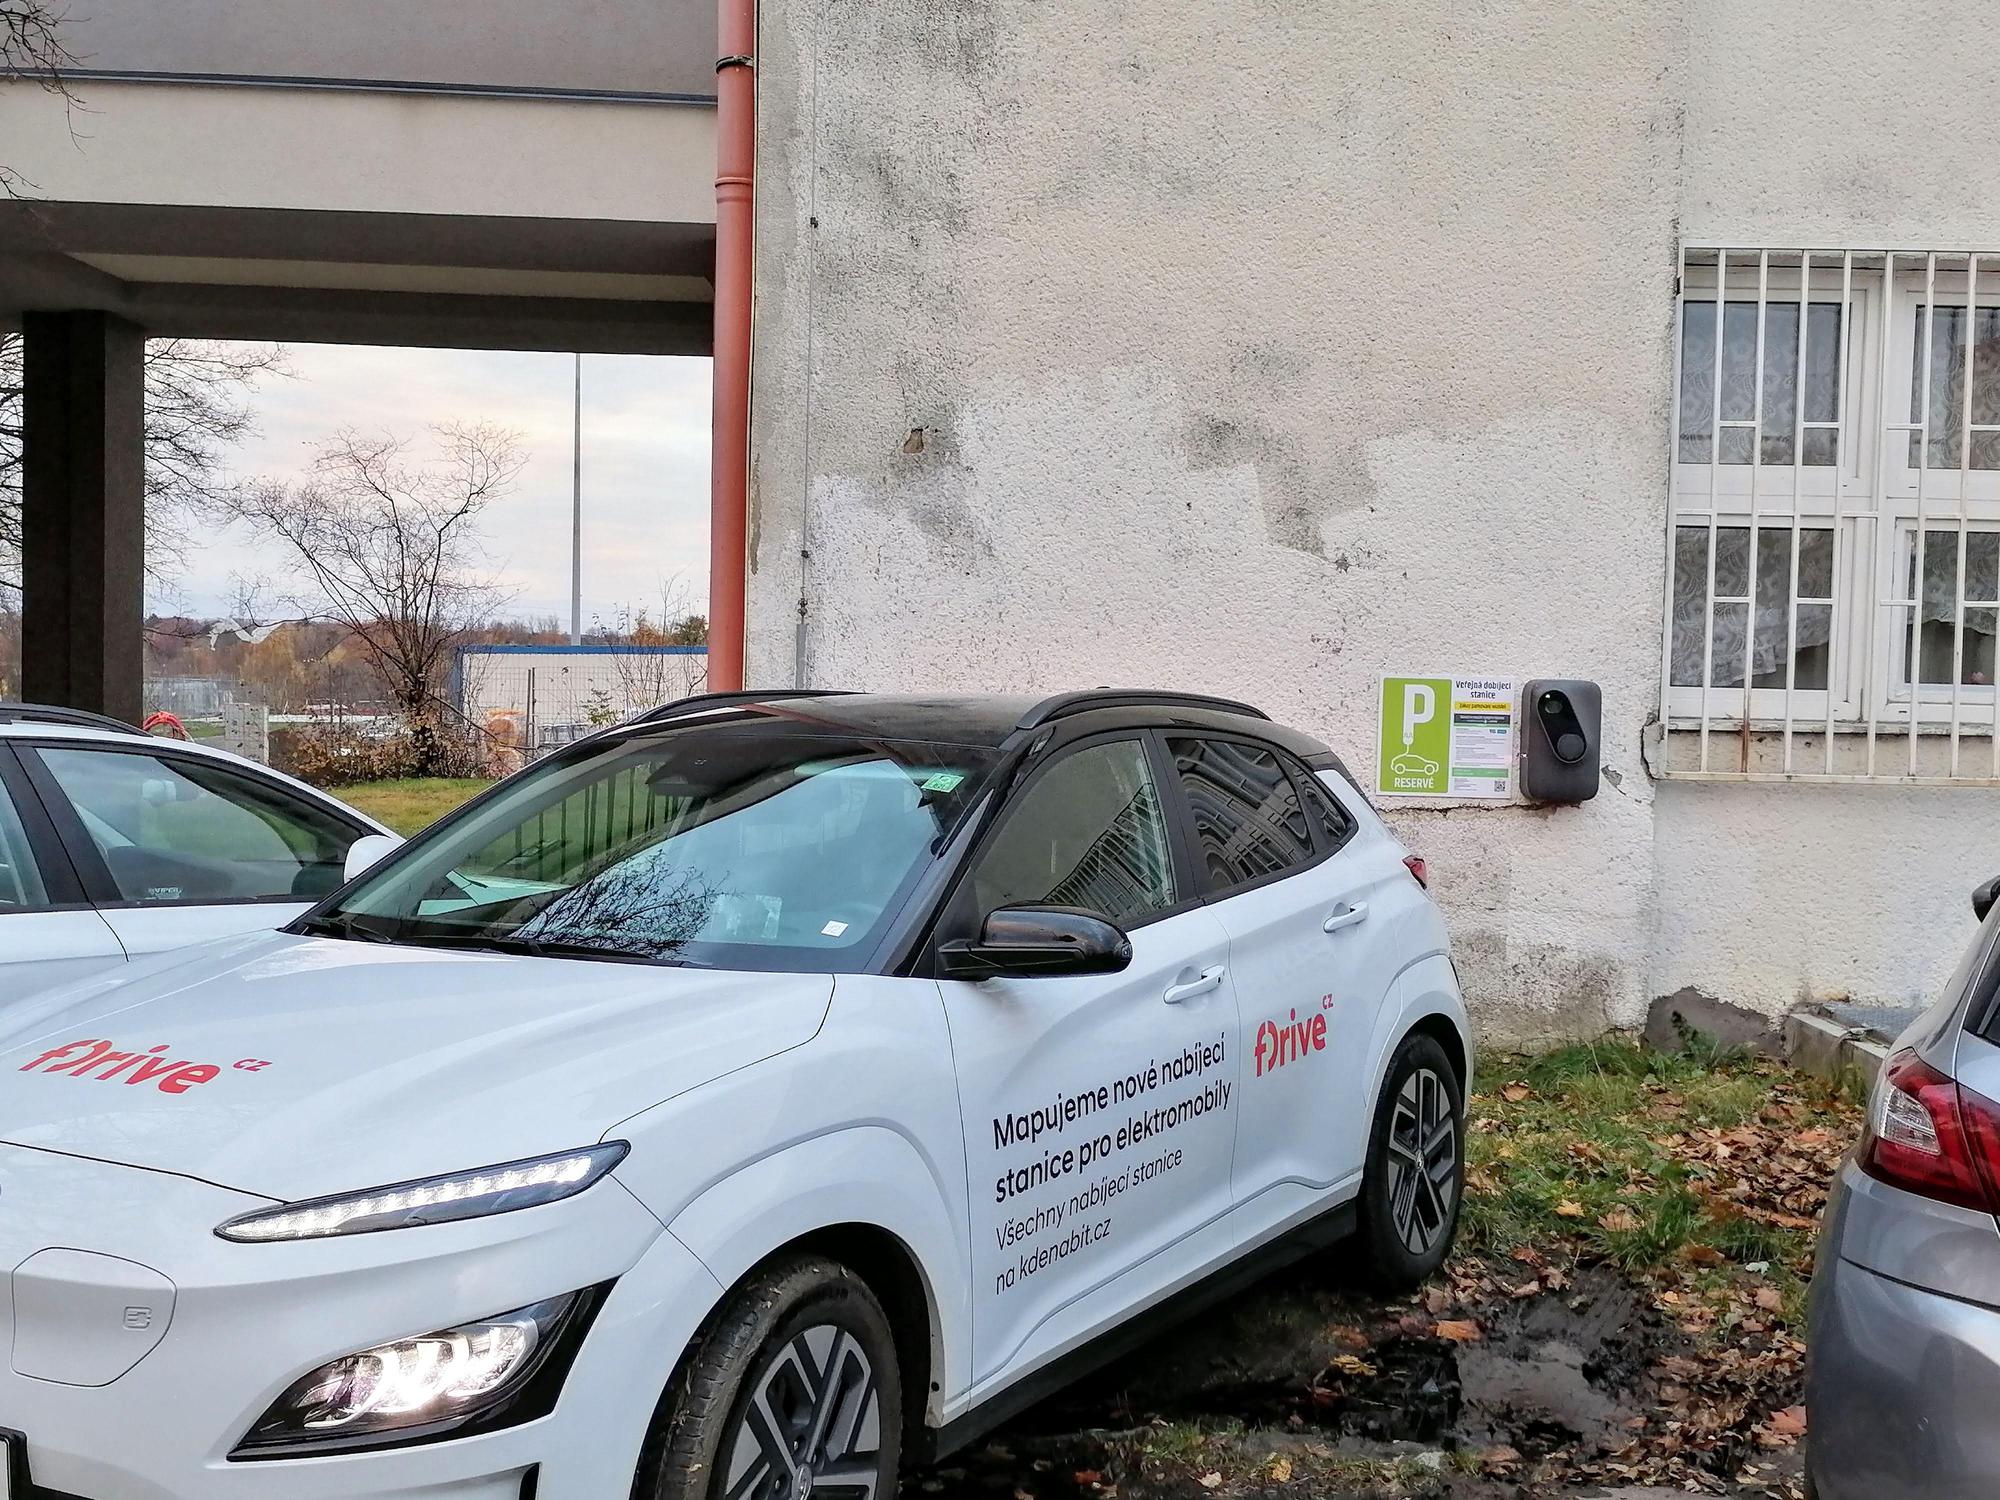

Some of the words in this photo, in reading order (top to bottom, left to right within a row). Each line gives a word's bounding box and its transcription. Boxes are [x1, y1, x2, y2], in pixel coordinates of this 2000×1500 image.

[1402, 684, 1436, 745] P
[1470, 690, 1496, 699] stanice
[993, 1093, 1109, 1150] Mapujeme
[1113, 1058, 1158, 1104] nové
[1161, 1031, 1226, 1086] nabíjecí
[995, 1150, 1075, 1203] stanice
[1079, 1134, 1112, 1174] pro
[1116, 1079, 1232, 1150] elektromobily
[995, 1199, 1066, 1252] Všechny
[1069, 1164, 1131, 1217] nabíjecí
[1132, 1148, 1183, 1187] stanice
[995, 1265, 1015, 1296] na
[1019, 1218, 1112, 1281] kdenabit.cz
